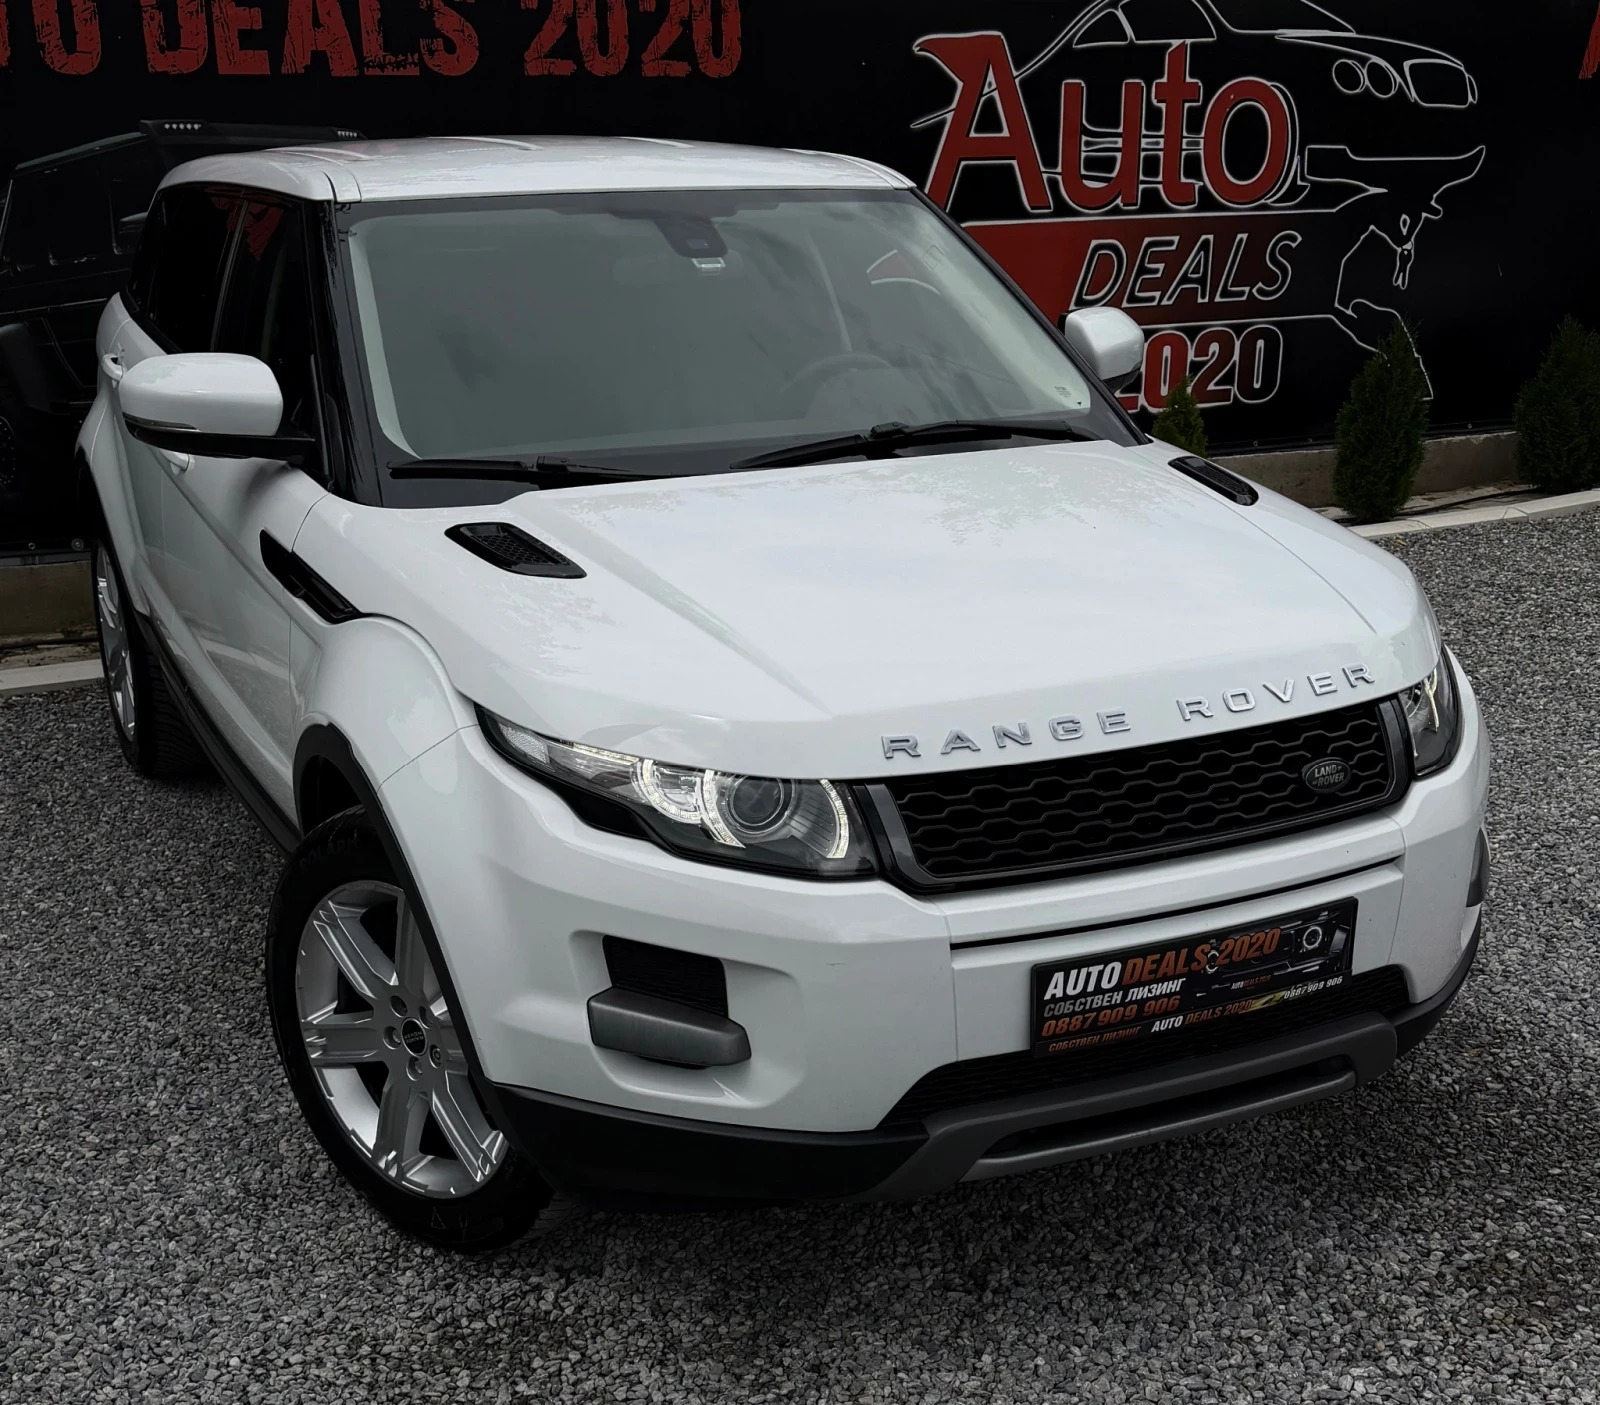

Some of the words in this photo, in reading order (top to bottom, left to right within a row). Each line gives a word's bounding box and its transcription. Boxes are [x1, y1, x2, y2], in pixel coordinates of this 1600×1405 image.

[141, 0, 480, 77] DEALS
[522, 0, 743, 78] 2020
[914, 32, 1292, 213] Auto
[1068, 230, 1302, 310] DEALS
[1115, 324, 1283, 413] 020
[881, 708, 1131, 759] RANGE
[1176, 662, 1375, 721] ROVER
[1314, 764, 1337, 778] LAND
[1317, 772, 1345, 787] ROVER
[1043, 961, 1122, 1000] AUTO
[1122, 943, 1212, 986] DEALS
[1215, 928, 1282, 967] 2020
[1042, 1012, 1097, 1037] 0887
[1098, 1004, 1138, 1026] 909
[1143, 995, 1181, 1017] 906
[1044, 990, 1123, 1018] СОБСТВЕН
[1125, 978, 1187, 1003] ЛИЗИНГ
[1151, 1015, 1184, 1033] AUTO
[1185, 1006, 1221, 1025] DEALS
[1224, 999, 1251, 1016] 2020
[1049, 1035, 1100, 1052] СОБСТВЕН
